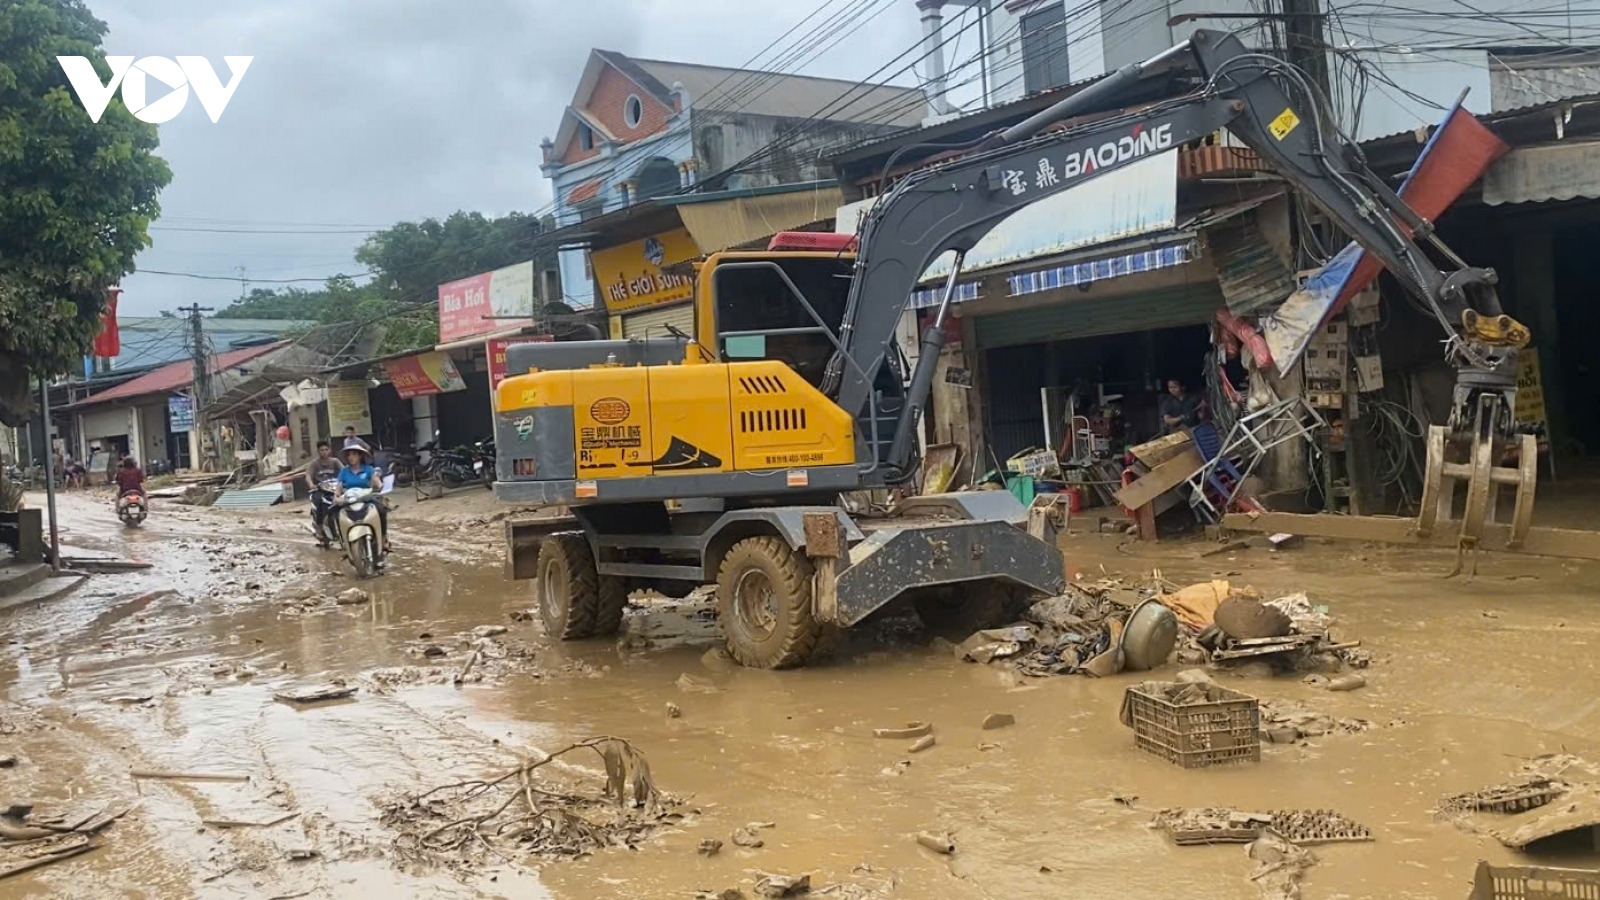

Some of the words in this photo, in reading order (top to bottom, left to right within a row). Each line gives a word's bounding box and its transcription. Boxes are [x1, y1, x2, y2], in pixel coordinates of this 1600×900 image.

[1064, 124, 1172, 179] BAODING
[1001, 158, 1060, 195] 宝鼎
[443, 294, 461, 312] Bia
